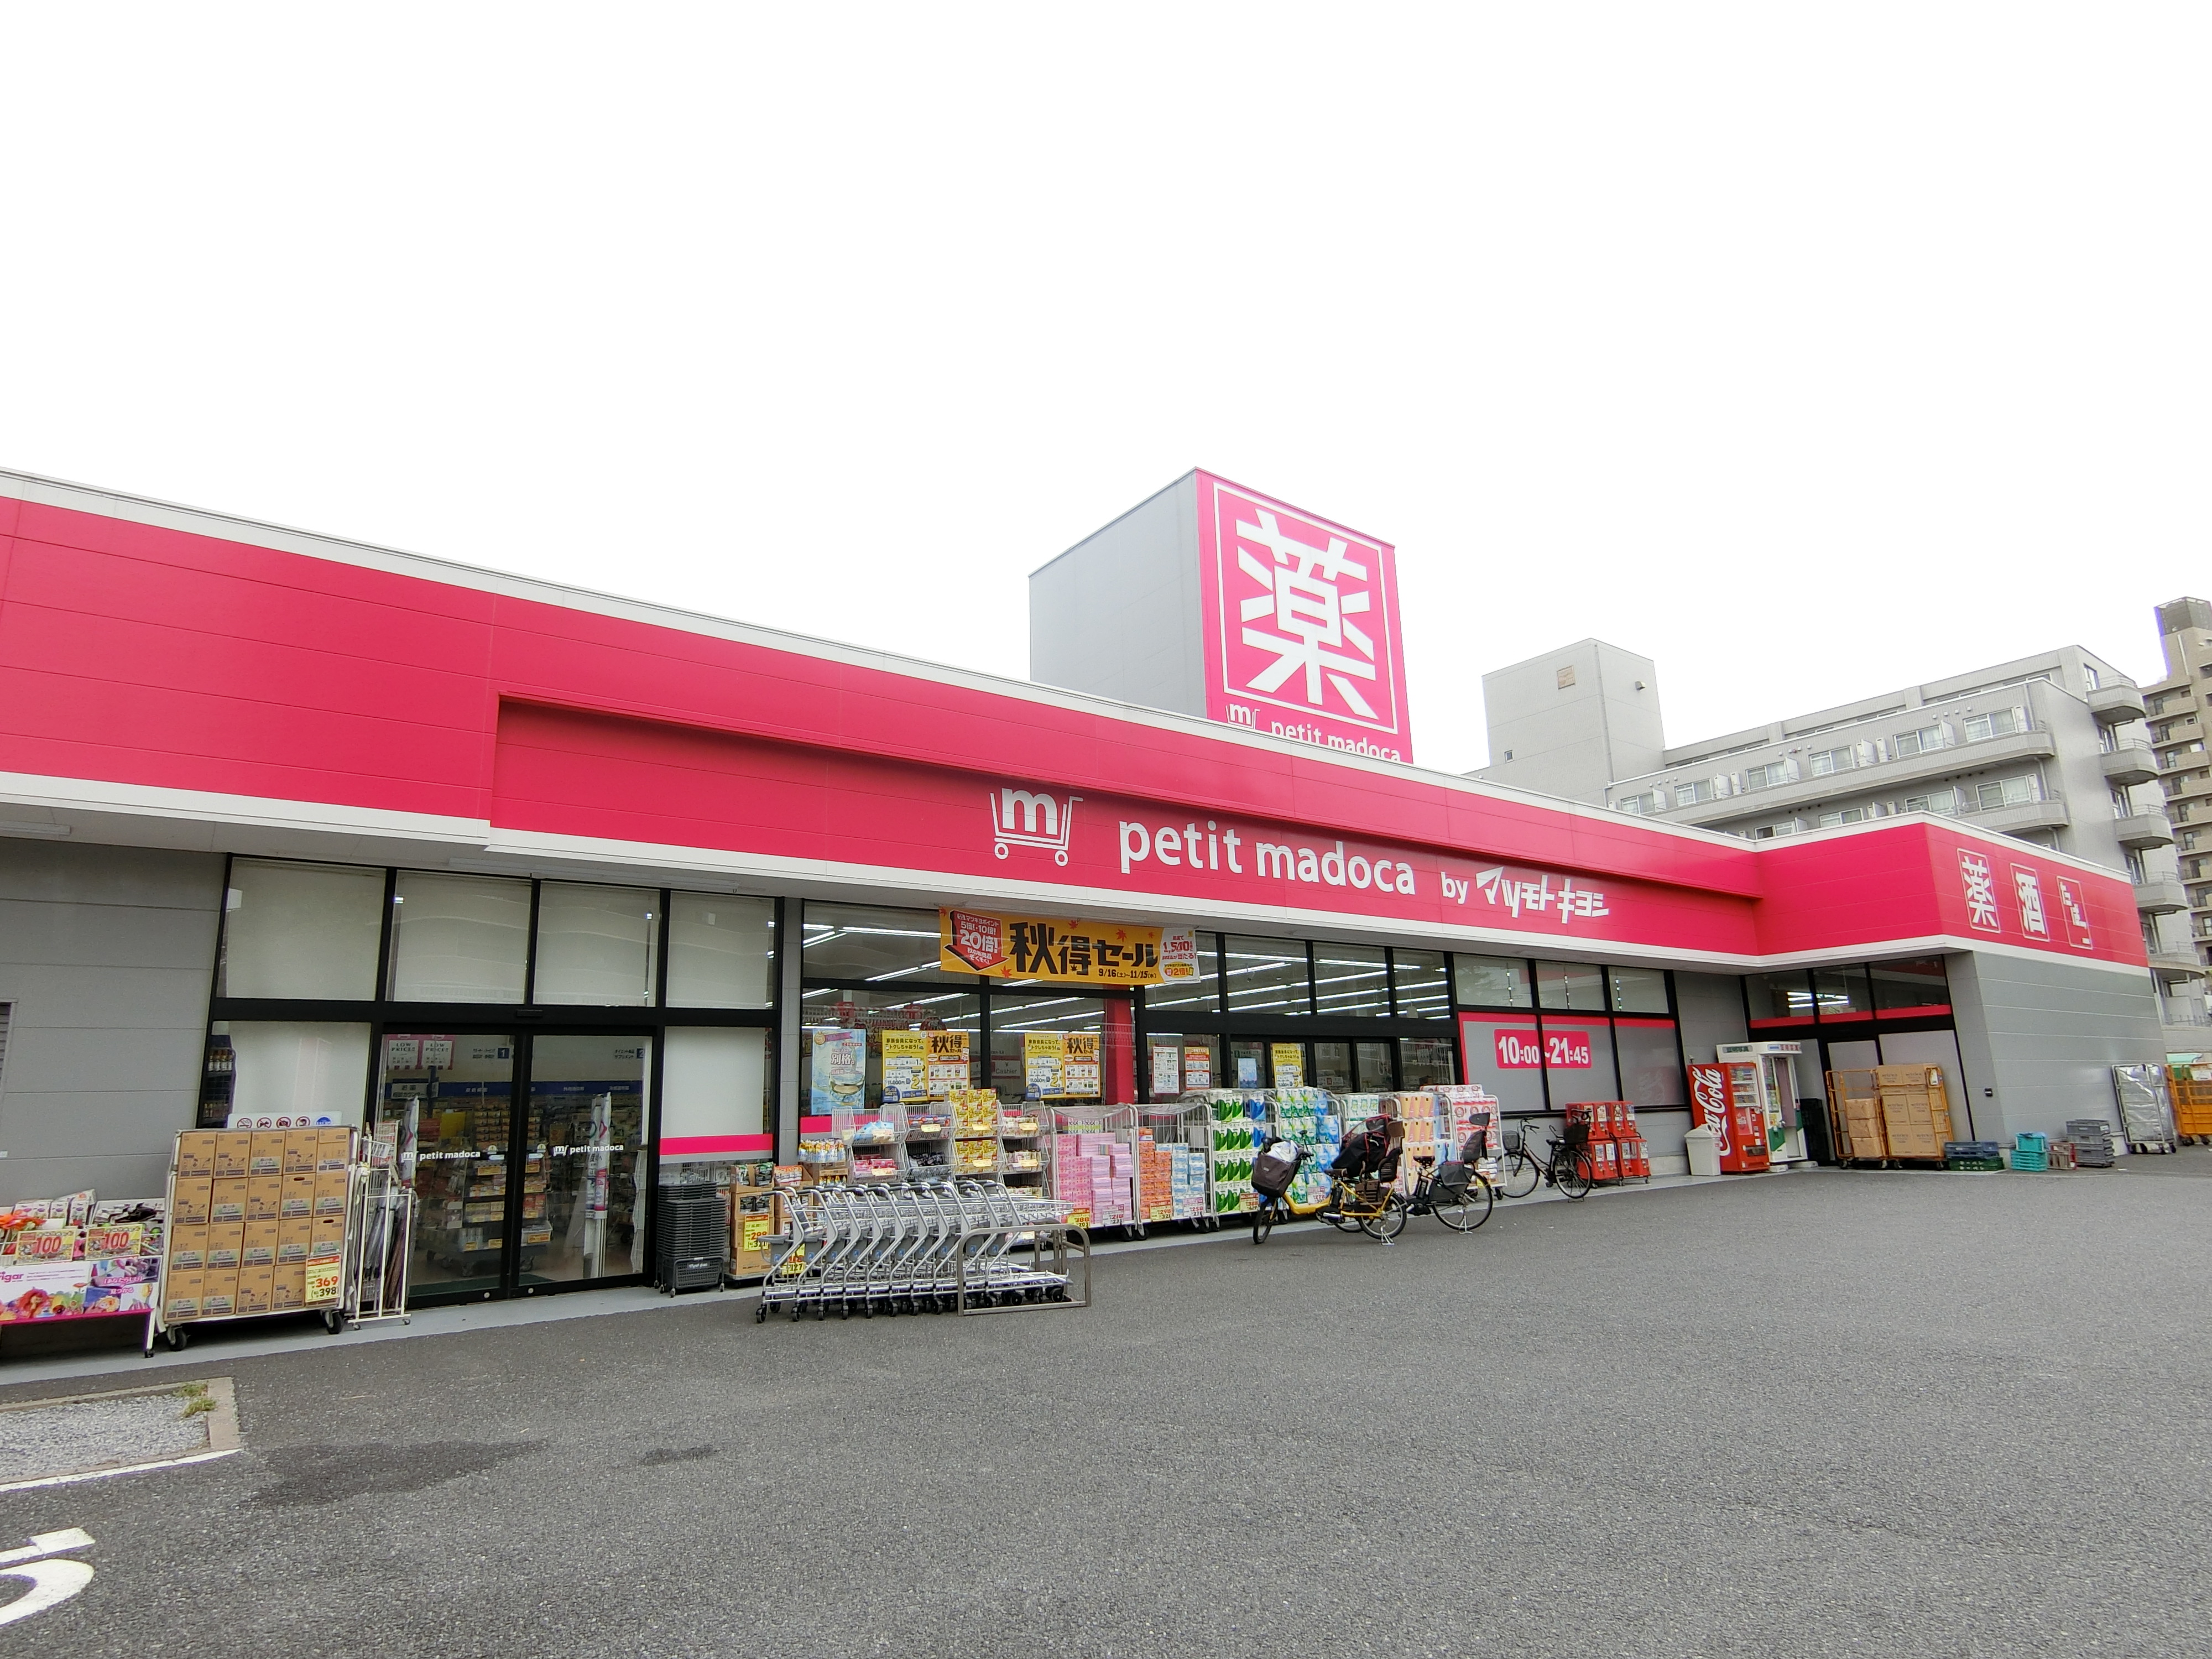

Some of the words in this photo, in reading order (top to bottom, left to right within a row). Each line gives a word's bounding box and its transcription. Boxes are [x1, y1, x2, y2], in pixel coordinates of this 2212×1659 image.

[1235, 508, 1379, 720] 薬
[1271, 721, 1322, 745] petit
[1327, 732, 1401, 762] madoca
[1119, 821, 1243, 874] petit
[1255, 841, 1416, 896] madoca
[1441, 872, 1468, 905] by
[1475, 865, 1610, 925] マツモトキヨシ
[1961, 855, 1997, 927] 薬
[966, 915, 999, 927] マツキヨポイント
[959, 929, 998, 954] 20倍!
[1009, 922, 1158, 976] 秋得セール
[931, 1035, 962, 1053] 秋得
[1067, 1037, 1094, 1054] 秋得
[501, 1049, 505, 1057] 1
[831, 1053, 855, 1065] 別格。
[419, 1151, 444, 1161] petit
[445, 1150, 481, 1159] madoca
[570, 1145, 591, 1155] petit
[35, 1236, 62, 1254] 100
[103, 1232, 129, 1249] 100
[315, 1276, 338, 1288] 369
